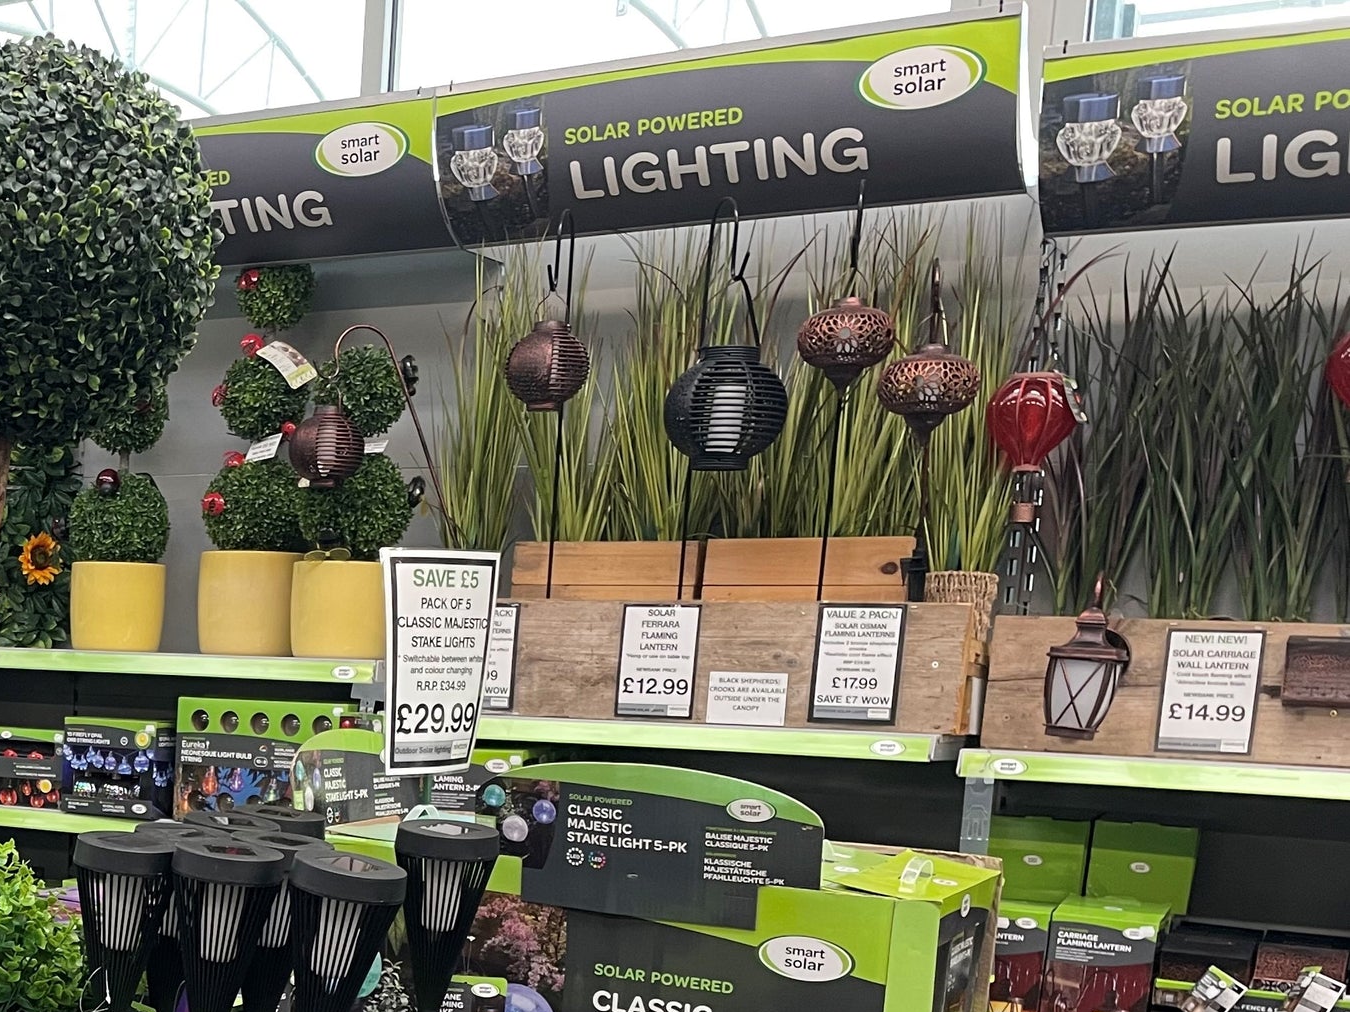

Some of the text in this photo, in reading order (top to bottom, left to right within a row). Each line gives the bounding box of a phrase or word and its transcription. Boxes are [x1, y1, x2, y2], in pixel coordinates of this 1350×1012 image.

[893, 59, 947, 81] smart
[893, 73, 947, 95] solar
[564, 107, 743, 146] SOLAR POWERED
[569, 127, 870, 200] LIGHTING
[413, 569, 479, 588] SAVE £5
[421, 598, 471, 609] PACK OF 5
[827, 610, 856, 618] VALUE
[397, 617, 488, 629] CLASSIC MAJESTIC
[412, 637, 475, 648] STAKE LIGHTS
[1185, 635, 1248, 644] NEW! NEW!
[1172, 649, 1256, 659] SOLAR CARRIAGE
[447, 667, 472, 675] changing
[1177, 661, 1249, 671] WALL LANTERN
[440, 681, 465, 690] £34.99
[622, 678, 688, 695] £12.99
[832, 677, 877, 689] £17.99
[817, 695, 842, 703] SAVE
[862, 696, 890, 704] WOW
[397, 703, 475, 734] £29.99
[1169, 703, 1245, 722] £14.99
[568, 804, 622, 820] CLASSIC
[567, 818, 632, 834] MAJESTIC
[567, 831, 688, 853] STAKE LIGHT 5-PK
[705, 832, 773, 844] BALISE MAJESTIC
[704, 858, 752, 868] KLASSISCHE
[1058, 931, 1098, 941] CARRIAGE
[785, 944, 826, 961] smart
[1057, 938, 1132, 953] FLAMING LANTERN
[784, 956, 825, 972] solar
[594, 963, 734, 994] SOLAR POWERED
